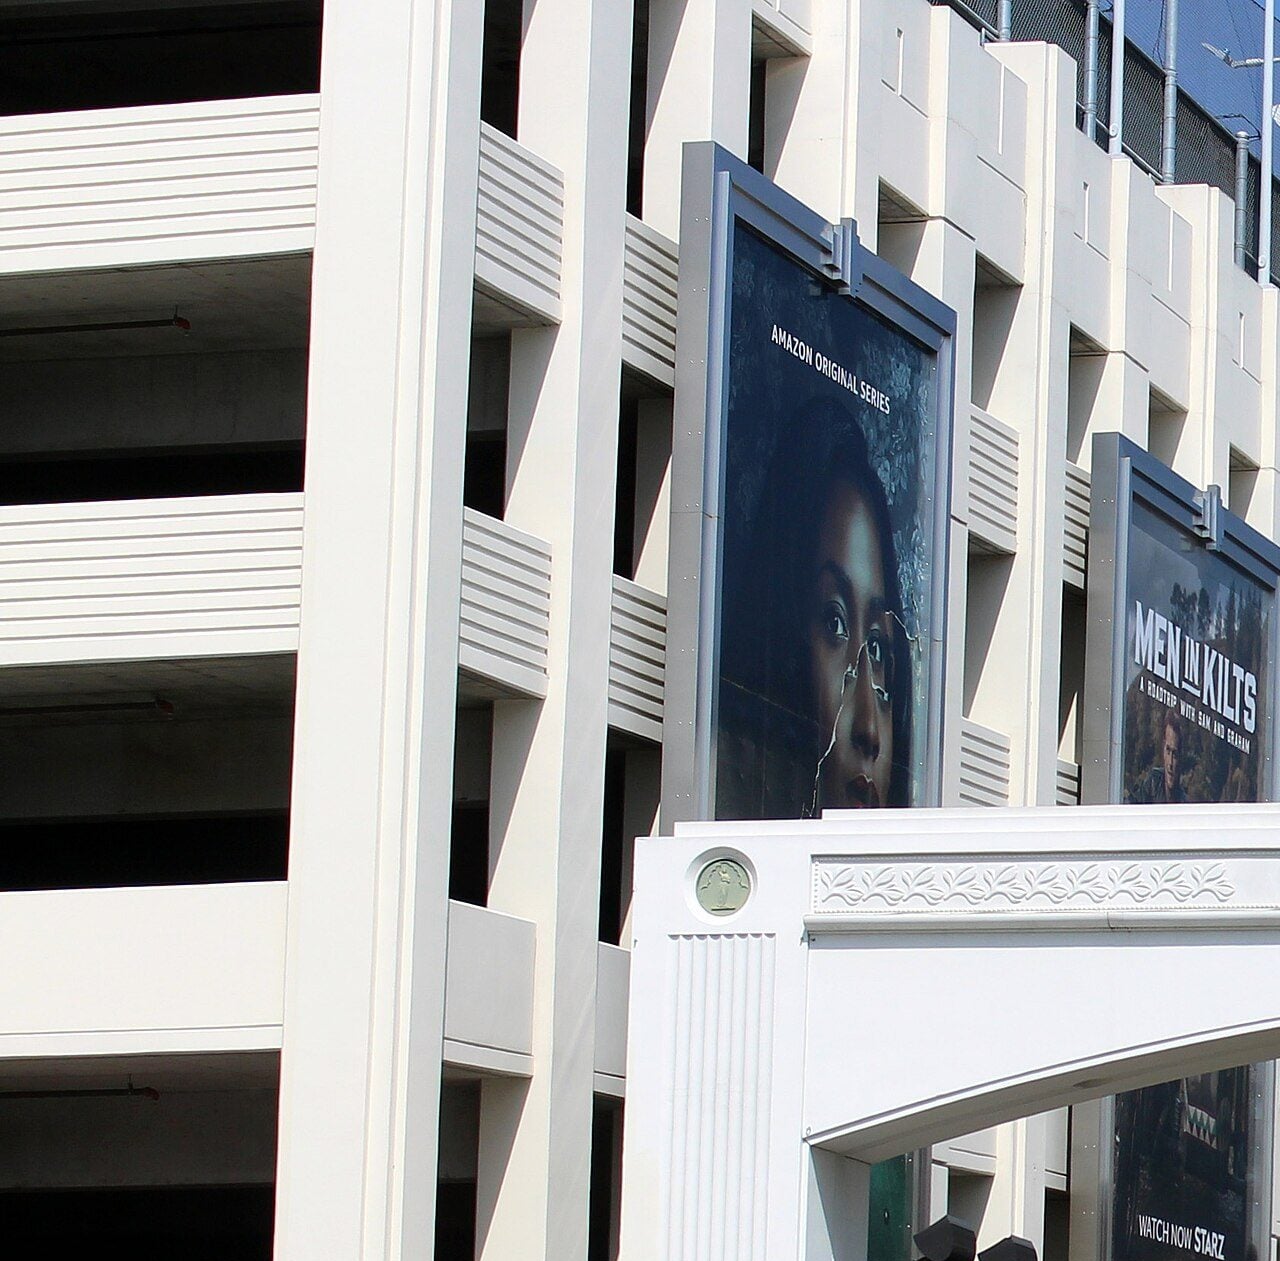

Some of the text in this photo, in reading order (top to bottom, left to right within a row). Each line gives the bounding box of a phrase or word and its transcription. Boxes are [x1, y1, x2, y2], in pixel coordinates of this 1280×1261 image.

[771, 324, 890, 415] AMAZON ORIGINAL SERIES
[1134, 600, 1257, 734] MEN IN KILTS
[1139, 676, 1250, 755] A ROADTRIP WITH SAM AND GRAHAM
[1139, 1214, 1225, 1260] WATCH NOW STARZ
